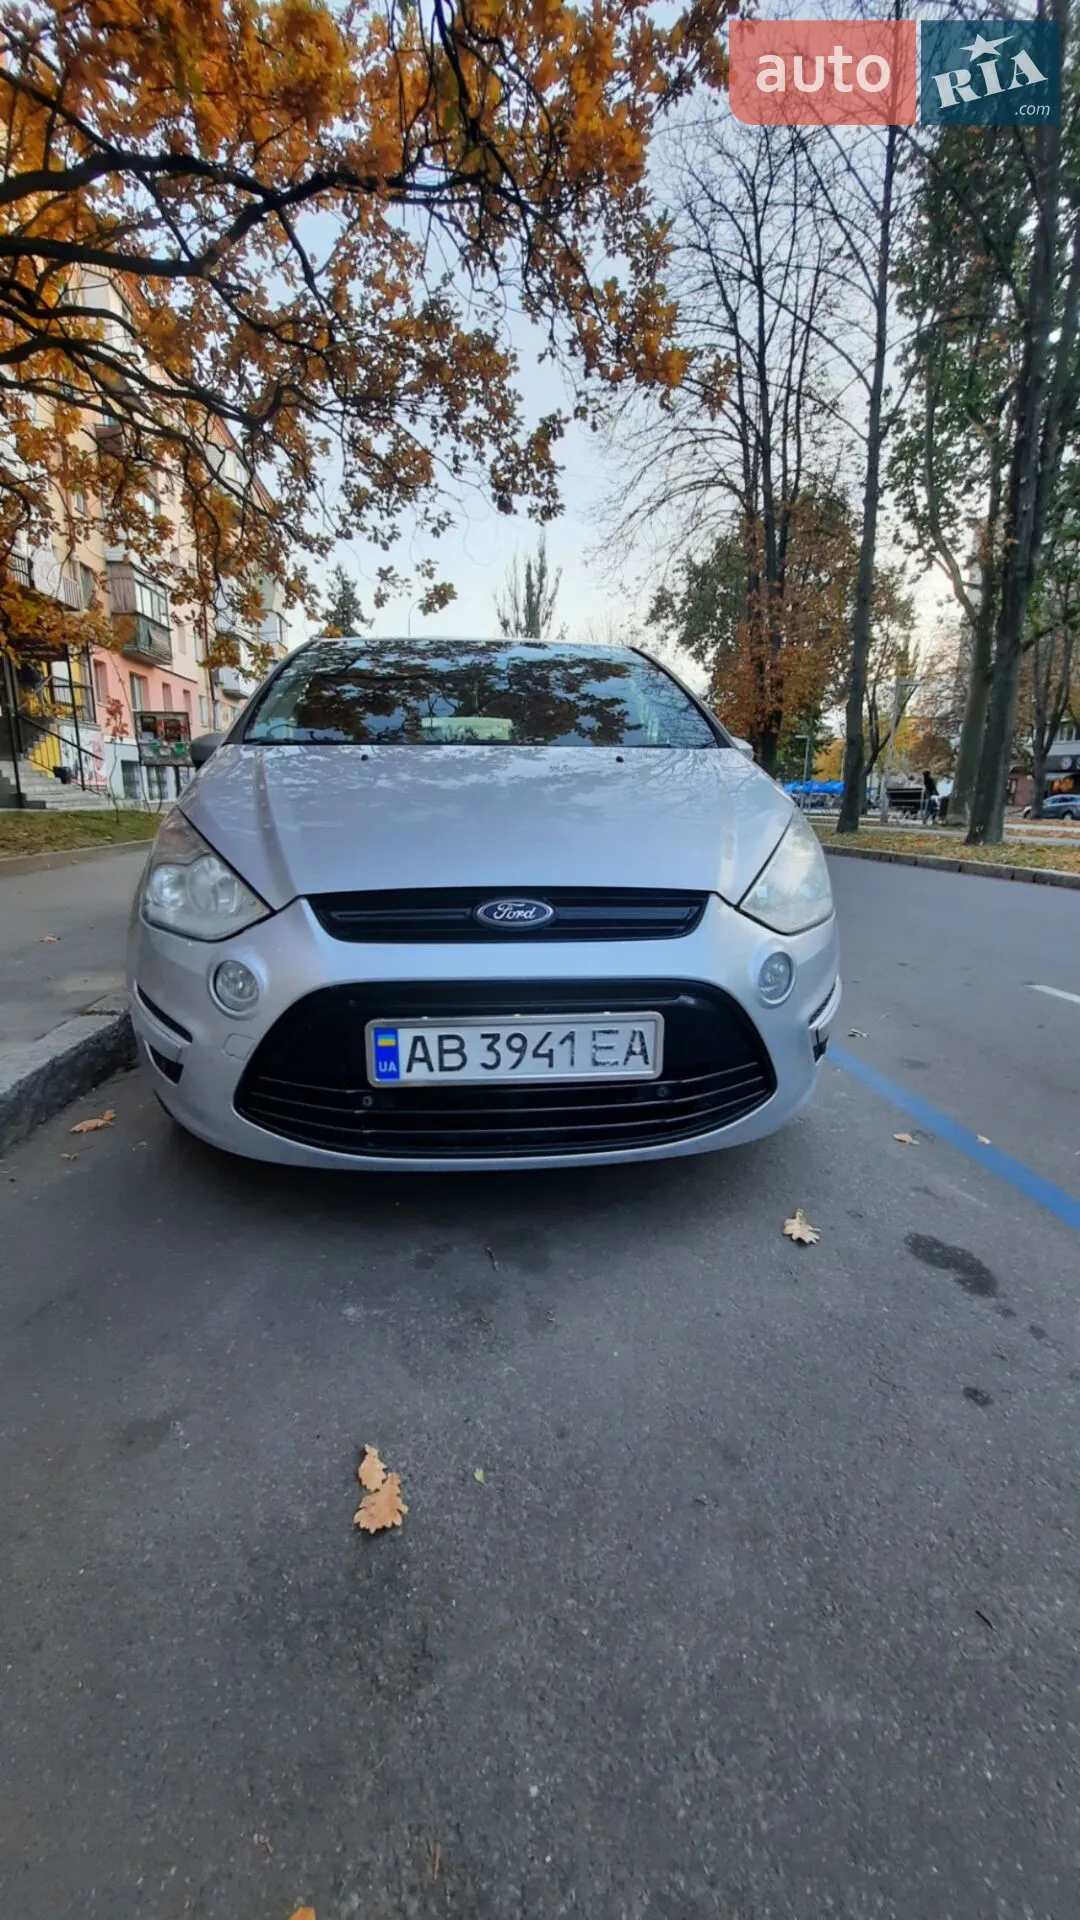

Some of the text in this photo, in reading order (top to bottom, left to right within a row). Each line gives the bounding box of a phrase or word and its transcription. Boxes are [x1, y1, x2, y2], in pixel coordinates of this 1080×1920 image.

[493, 902, 536, 921] Ford
[406, 1029, 650, 1073] AB 3941 EA
[378, 1060, 397, 1073] UA
